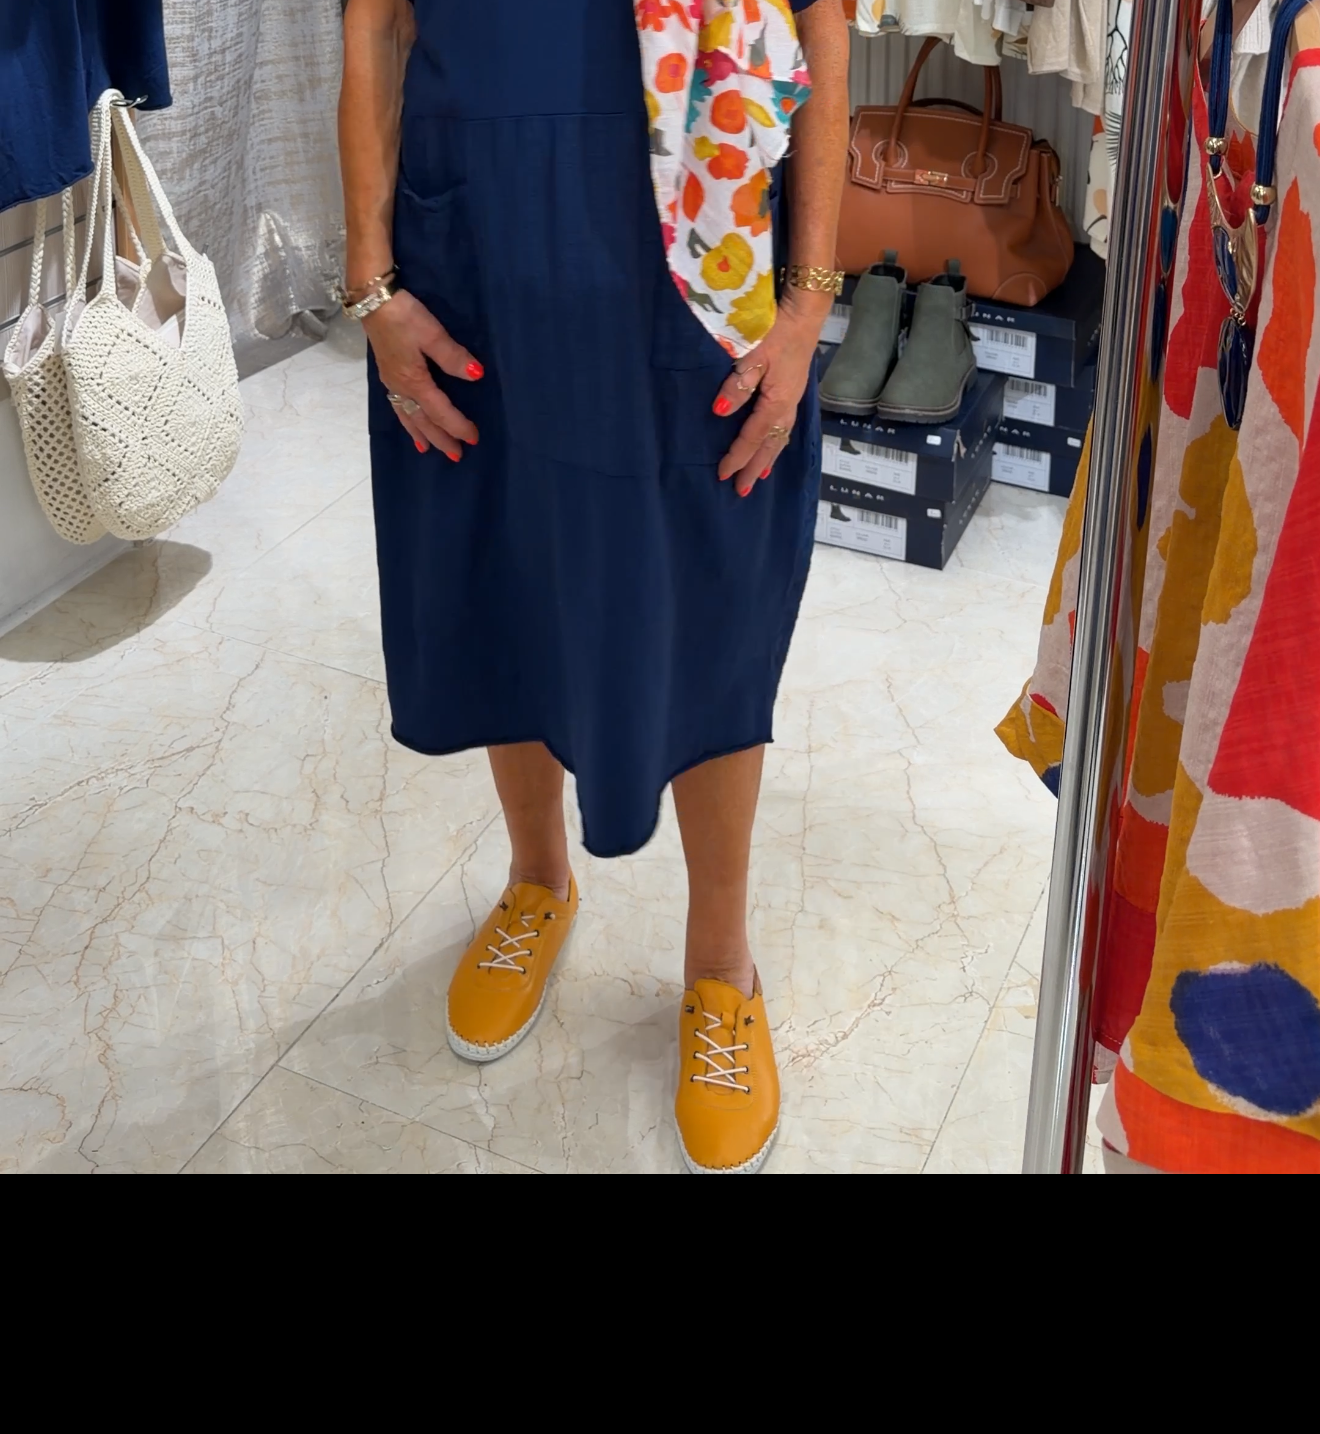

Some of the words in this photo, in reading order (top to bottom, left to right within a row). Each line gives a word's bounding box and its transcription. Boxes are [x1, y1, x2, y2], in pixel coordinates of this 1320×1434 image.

[974, 311, 1015, 323] UNAR
[839, 418, 896, 435] LUNAR
[999, 425, 1031, 437] NAR
[829, 484, 885, 501] LUNAR
